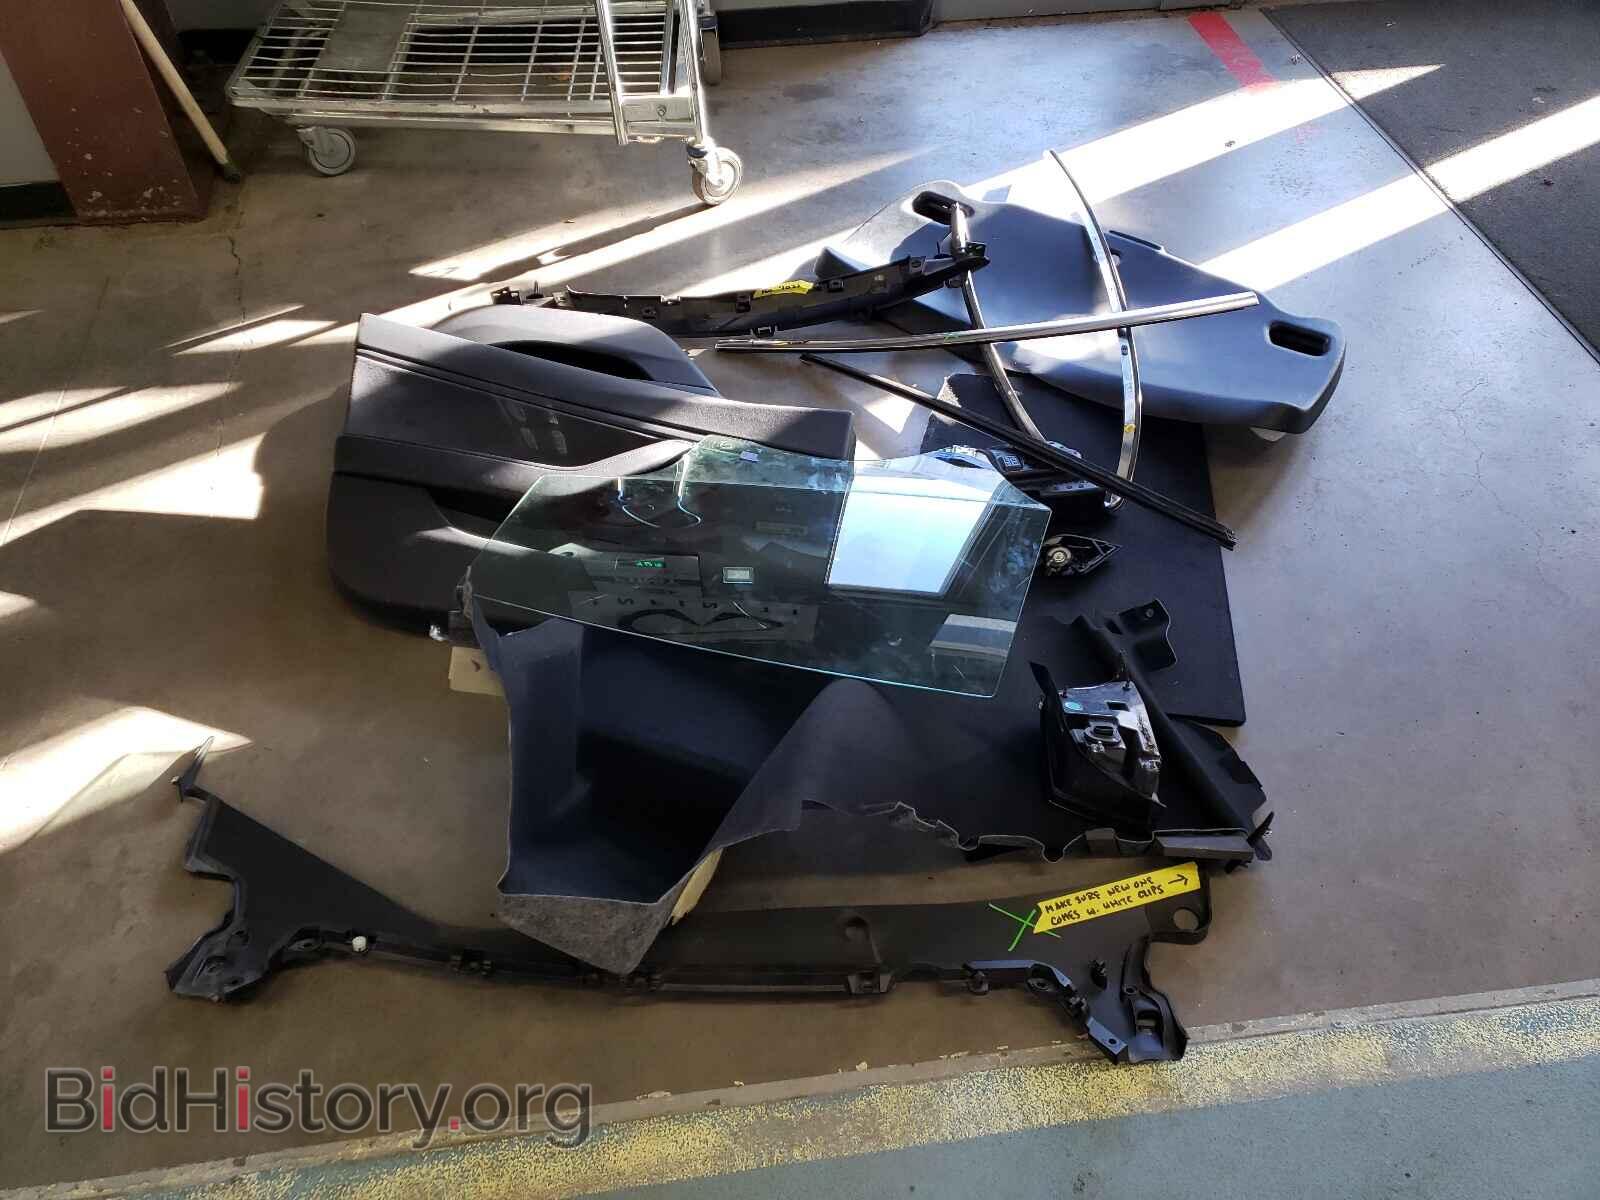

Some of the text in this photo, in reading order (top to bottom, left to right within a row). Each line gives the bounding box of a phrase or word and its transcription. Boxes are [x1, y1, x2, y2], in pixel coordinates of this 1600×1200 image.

[1045, 876, 1155, 914] MAKE SURE NEW ONE
[1051, 910, 1081, 926] COMES
[1103, 895, 1133, 909] WHITE
[1137, 885, 1164, 899] CLIPS
